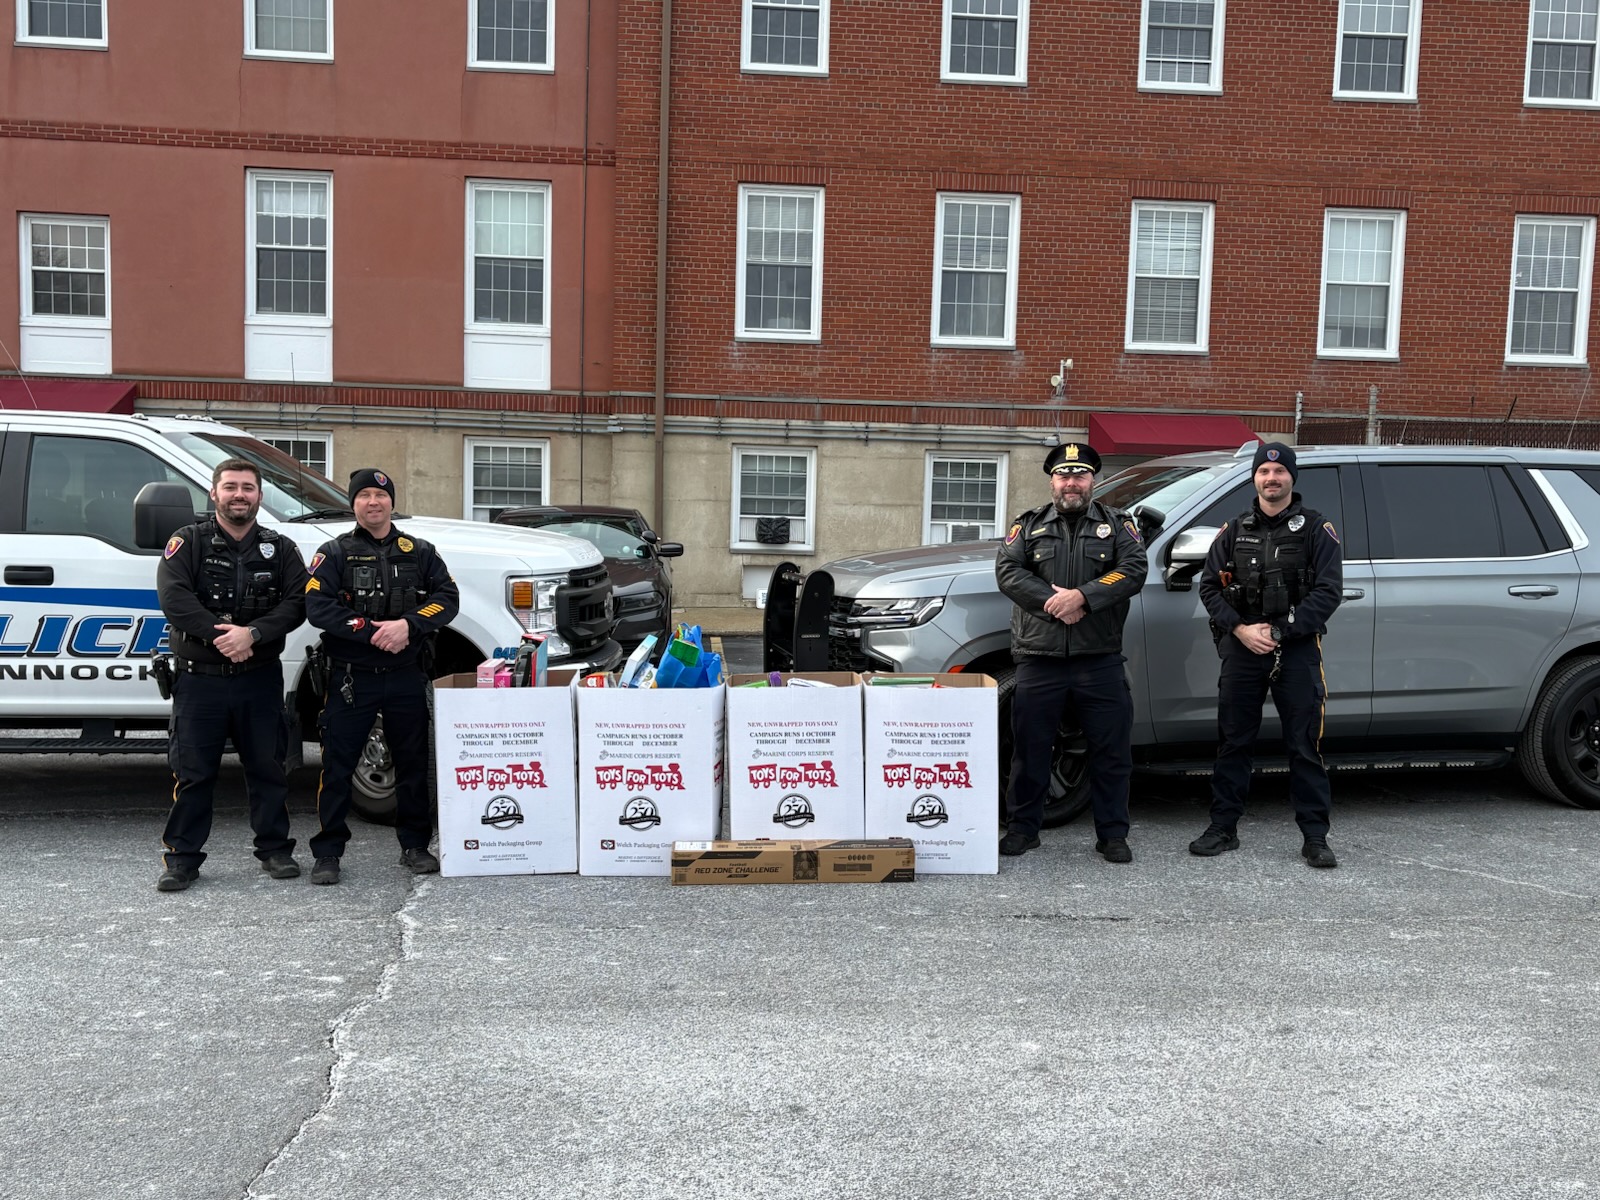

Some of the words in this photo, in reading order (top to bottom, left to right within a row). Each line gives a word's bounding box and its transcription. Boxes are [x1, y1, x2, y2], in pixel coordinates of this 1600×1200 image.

[458, 769, 482, 782] TOYS
[488, 771, 507, 782] FOR
[513, 771, 540, 783] TOTS
[597, 769, 621, 782] TOYS
[627, 772, 646, 783] FOR
[652, 773, 678, 784] TOTS
[751, 768, 775, 781] TOYS
[780, 770, 800, 781] FOR
[806, 770, 831, 782] TOTS
[885, 768, 909, 780] TOYS
[915, 770, 934, 782] FOR
[940, 771, 966, 782] TOTS
[492, 806, 517, 816] 250
[630, 807, 654, 818] 250
[783, 804, 808, 815] 250
[918, 804, 942, 815] 250
